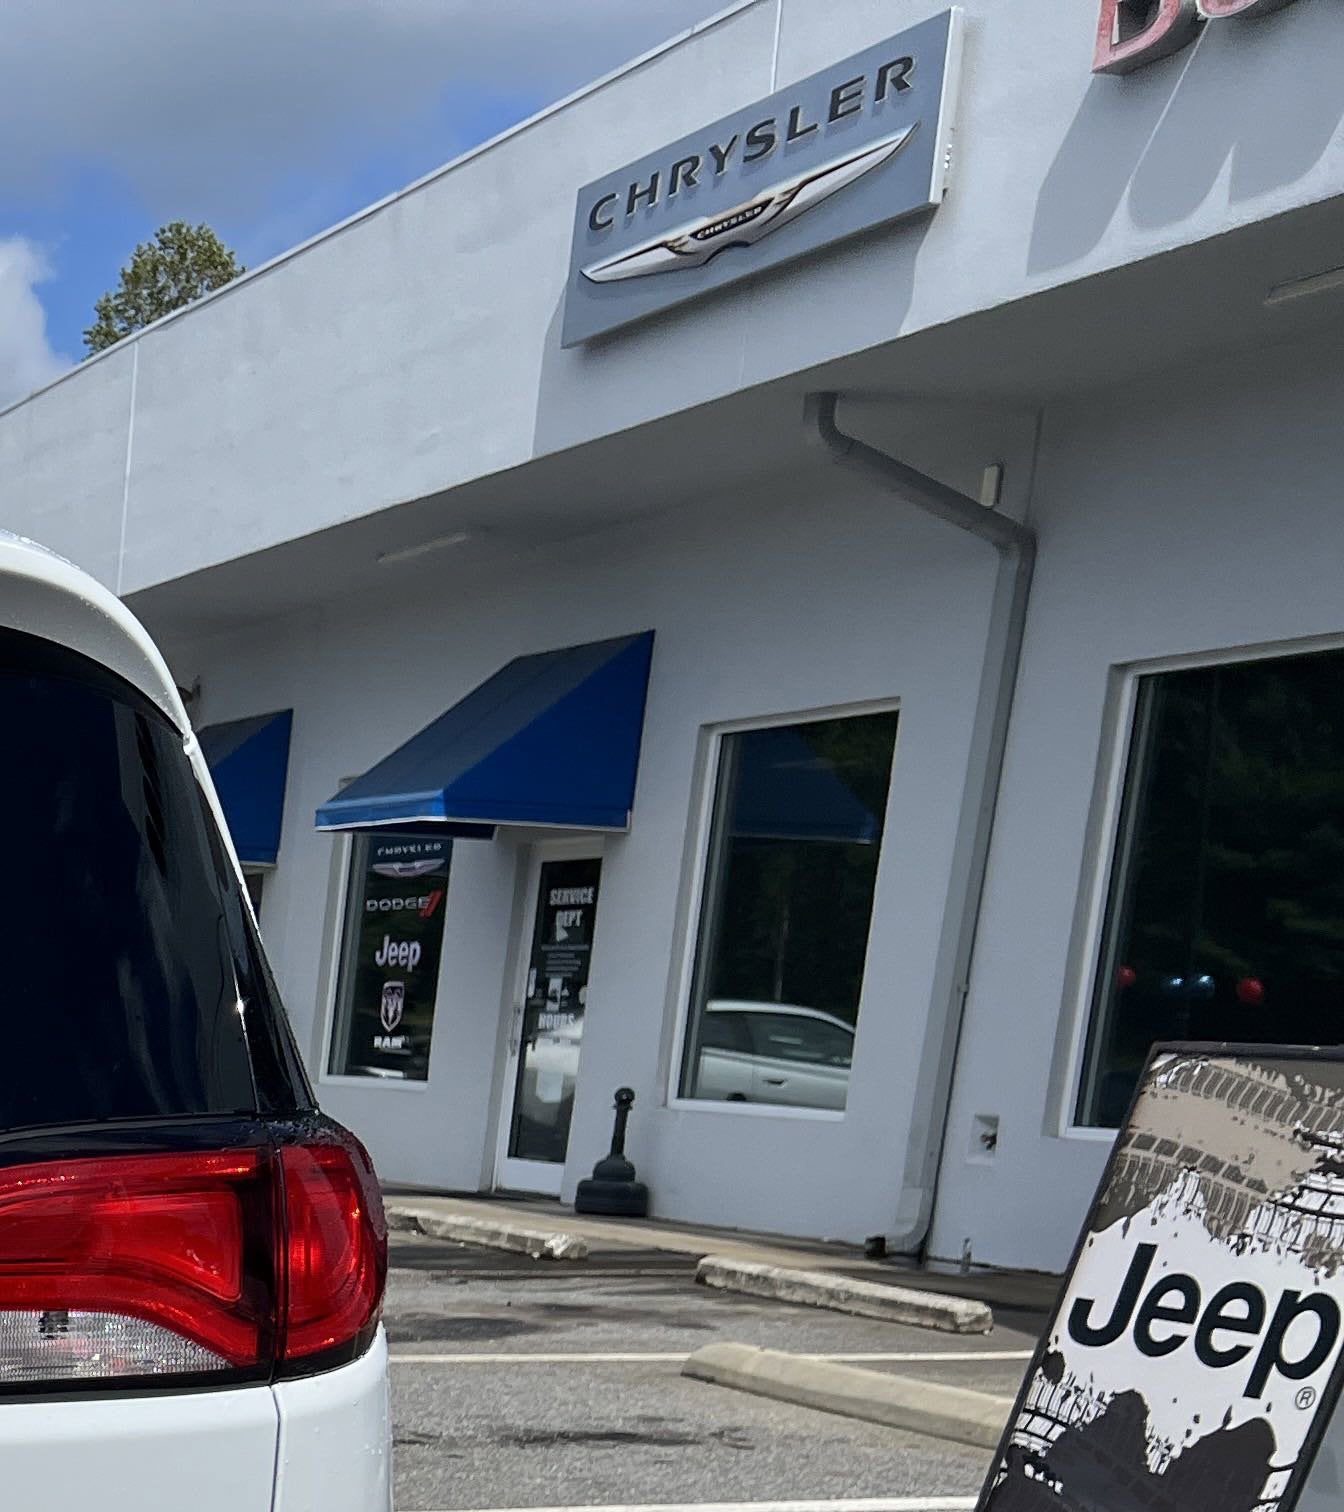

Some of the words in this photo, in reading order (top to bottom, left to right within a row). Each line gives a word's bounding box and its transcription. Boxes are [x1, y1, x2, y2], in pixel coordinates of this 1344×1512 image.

[589, 55, 916, 232] CHRYSLER
[366, 896, 430, 911] DODGE
[550, 887, 595, 906] SERVICE
[375, 934, 421, 972] Jeep
[374, 1035, 404, 1049] RAM
[1068, 1242, 1341, 1399] Jeep
